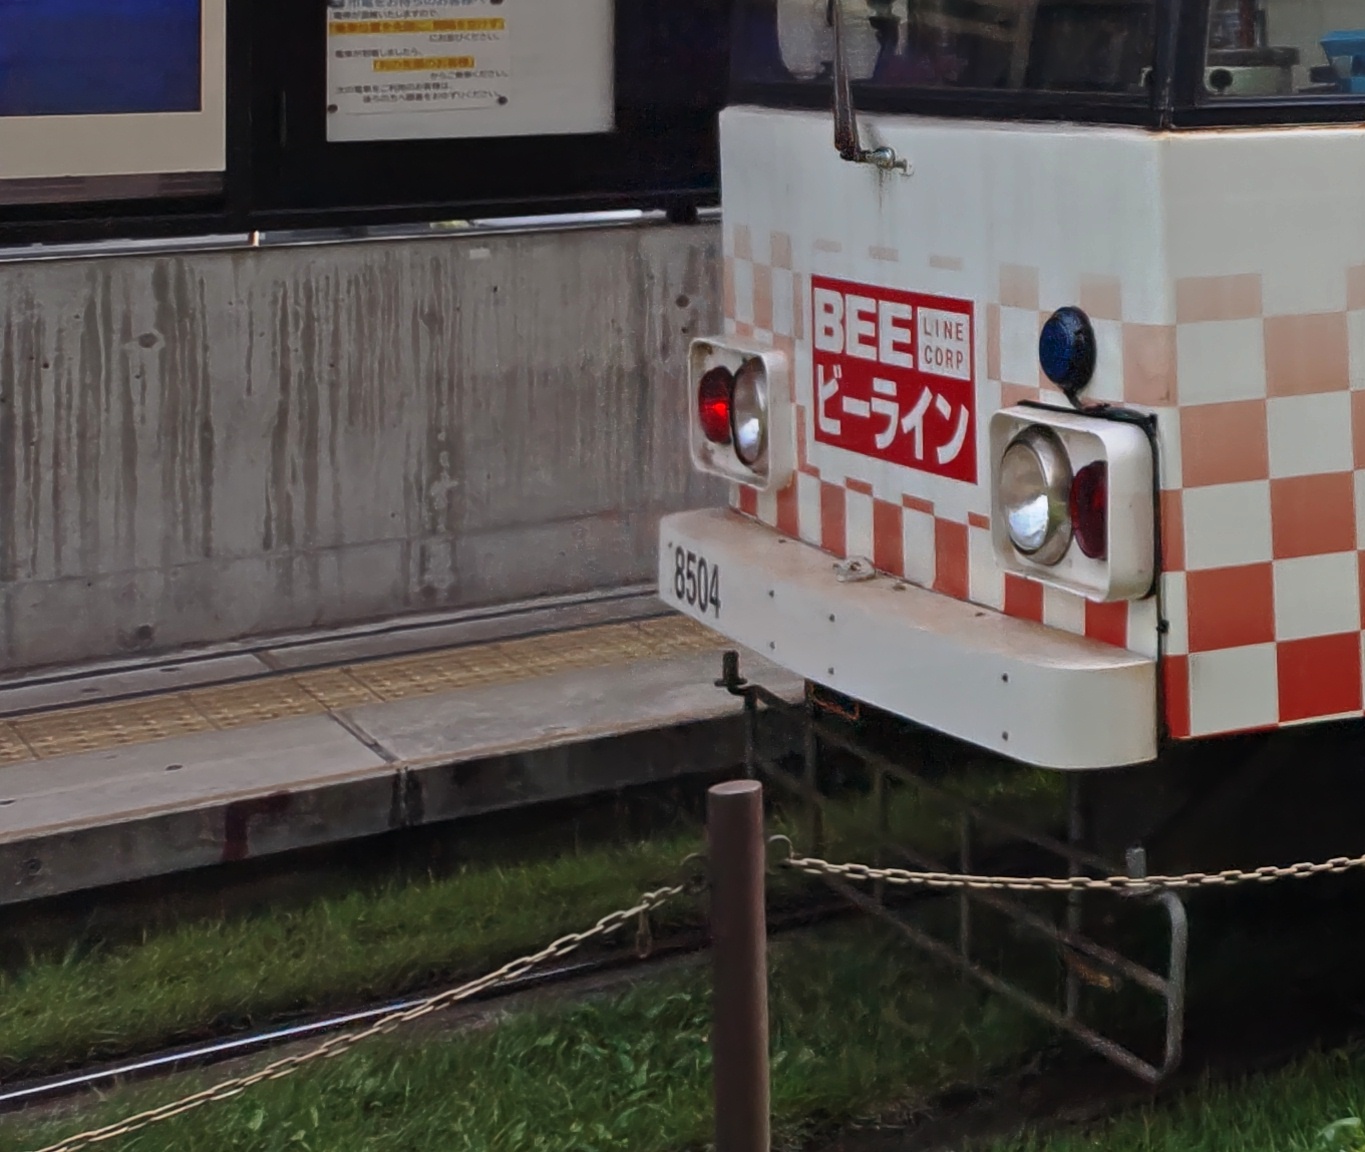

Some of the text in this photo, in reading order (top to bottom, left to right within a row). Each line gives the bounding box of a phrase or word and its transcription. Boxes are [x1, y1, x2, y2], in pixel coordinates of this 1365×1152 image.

[814, 287, 913, 368] BEE
[923, 317, 963, 341] LINE
[924, 345, 963, 369] CORP
[818, 364, 969, 464] ビーライン
[675, 545, 721, 619] 8504
